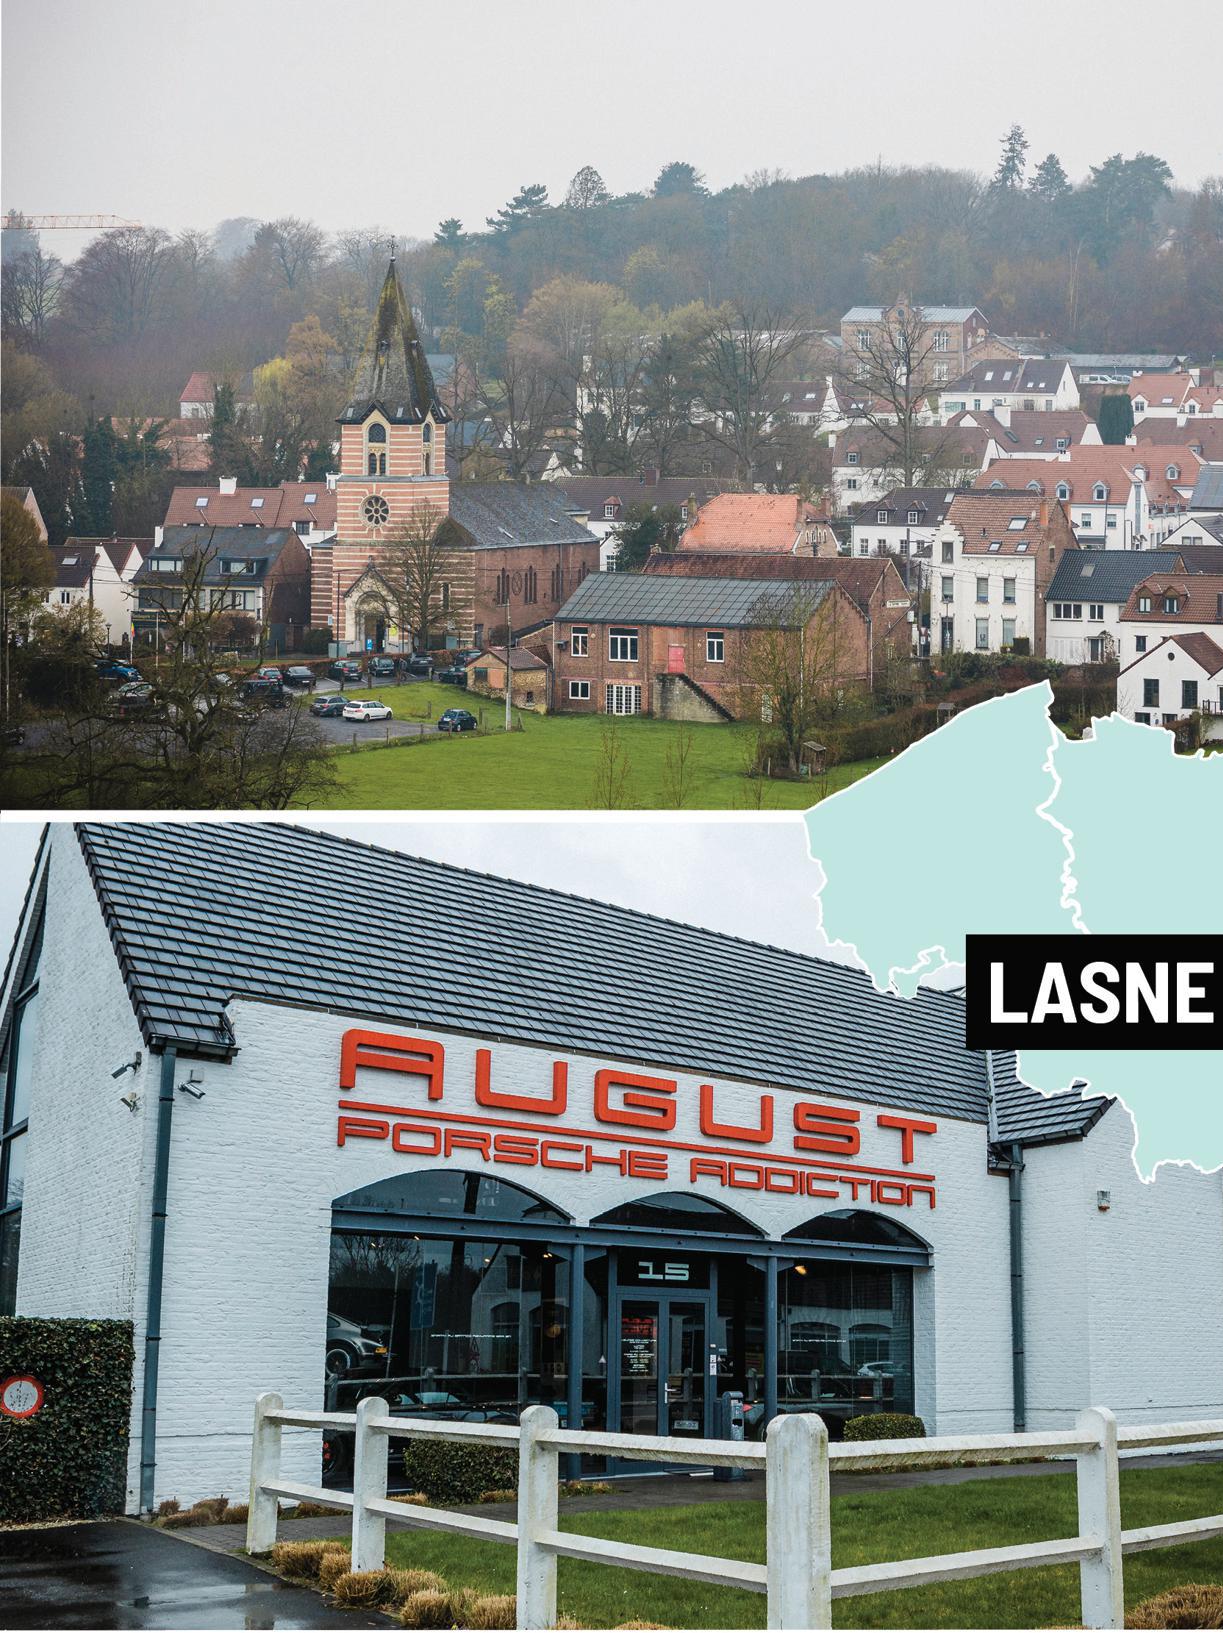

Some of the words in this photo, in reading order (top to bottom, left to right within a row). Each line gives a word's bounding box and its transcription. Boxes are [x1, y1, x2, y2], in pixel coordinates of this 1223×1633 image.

[340, 1029, 938, 1164] AUGUST
[337, 1116, 669, 1180] PORSCHE
[690, 1158, 937, 1209] ADDICTION
[638, 1261, 690, 1281] 15
